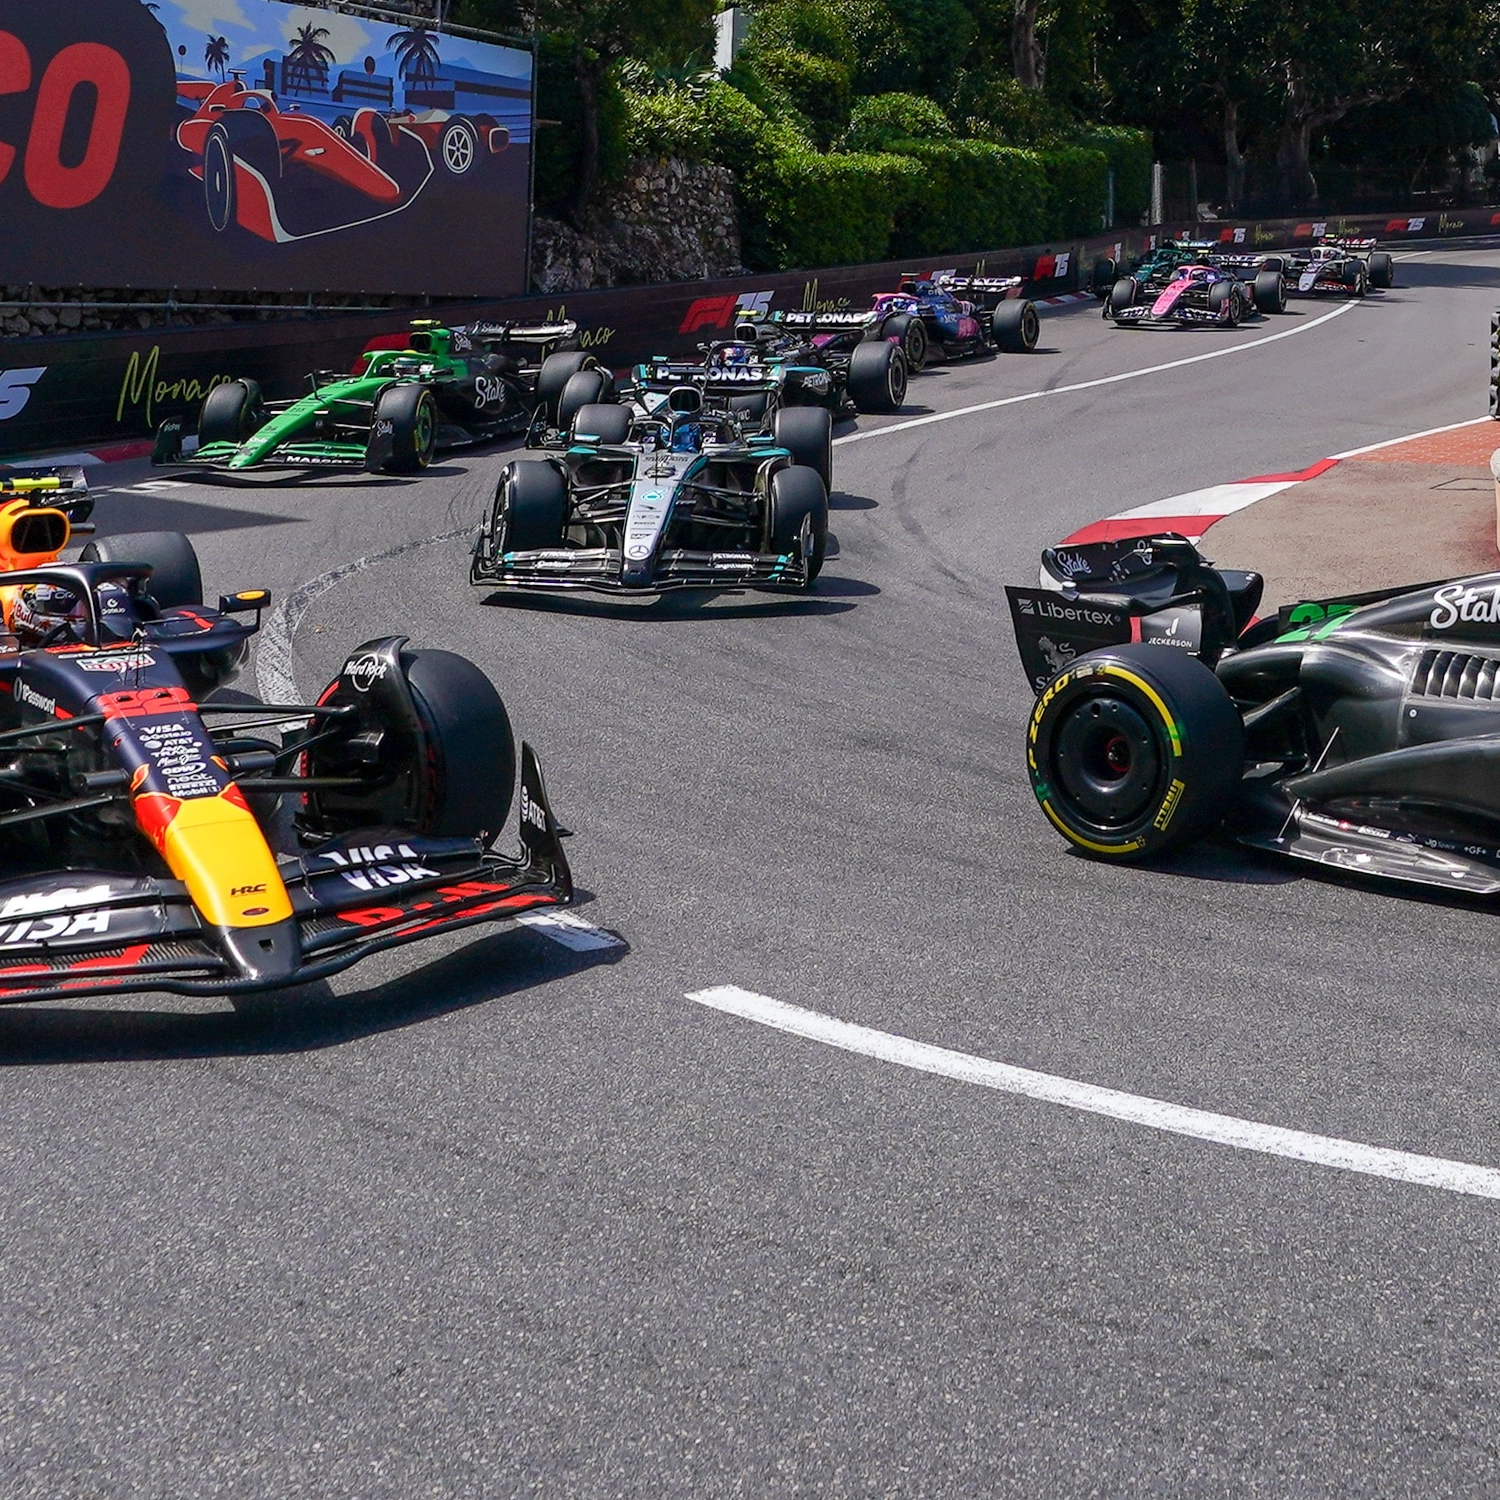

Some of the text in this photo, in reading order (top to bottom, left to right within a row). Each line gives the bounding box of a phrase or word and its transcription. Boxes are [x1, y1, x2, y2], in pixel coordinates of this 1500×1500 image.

[1054, 253, 1070, 277] 75
[679, 290, 775, 334] F1 75
[474, 376, 506, 409] Stake
[1056, 551, 1092, 577] Stake
[1037, 601, 1115, 627] Libertex
[1274, 603, 1362, 645] 27
[1148, 637, 1193, 649] JECKERSON
[344, 660, 367, 676] Hard
[22, 684, 56, 714] 1Password
[1029, 672, 1071, 745] ZERO
[140, 723, 185, 735] VISA
[528, 804, 547, 833] AT&T
[1153, 778, 1186, 832] PIRELLI
[319, 844, 441, 891] VISA
[230, 883, 267, 896] HRC
